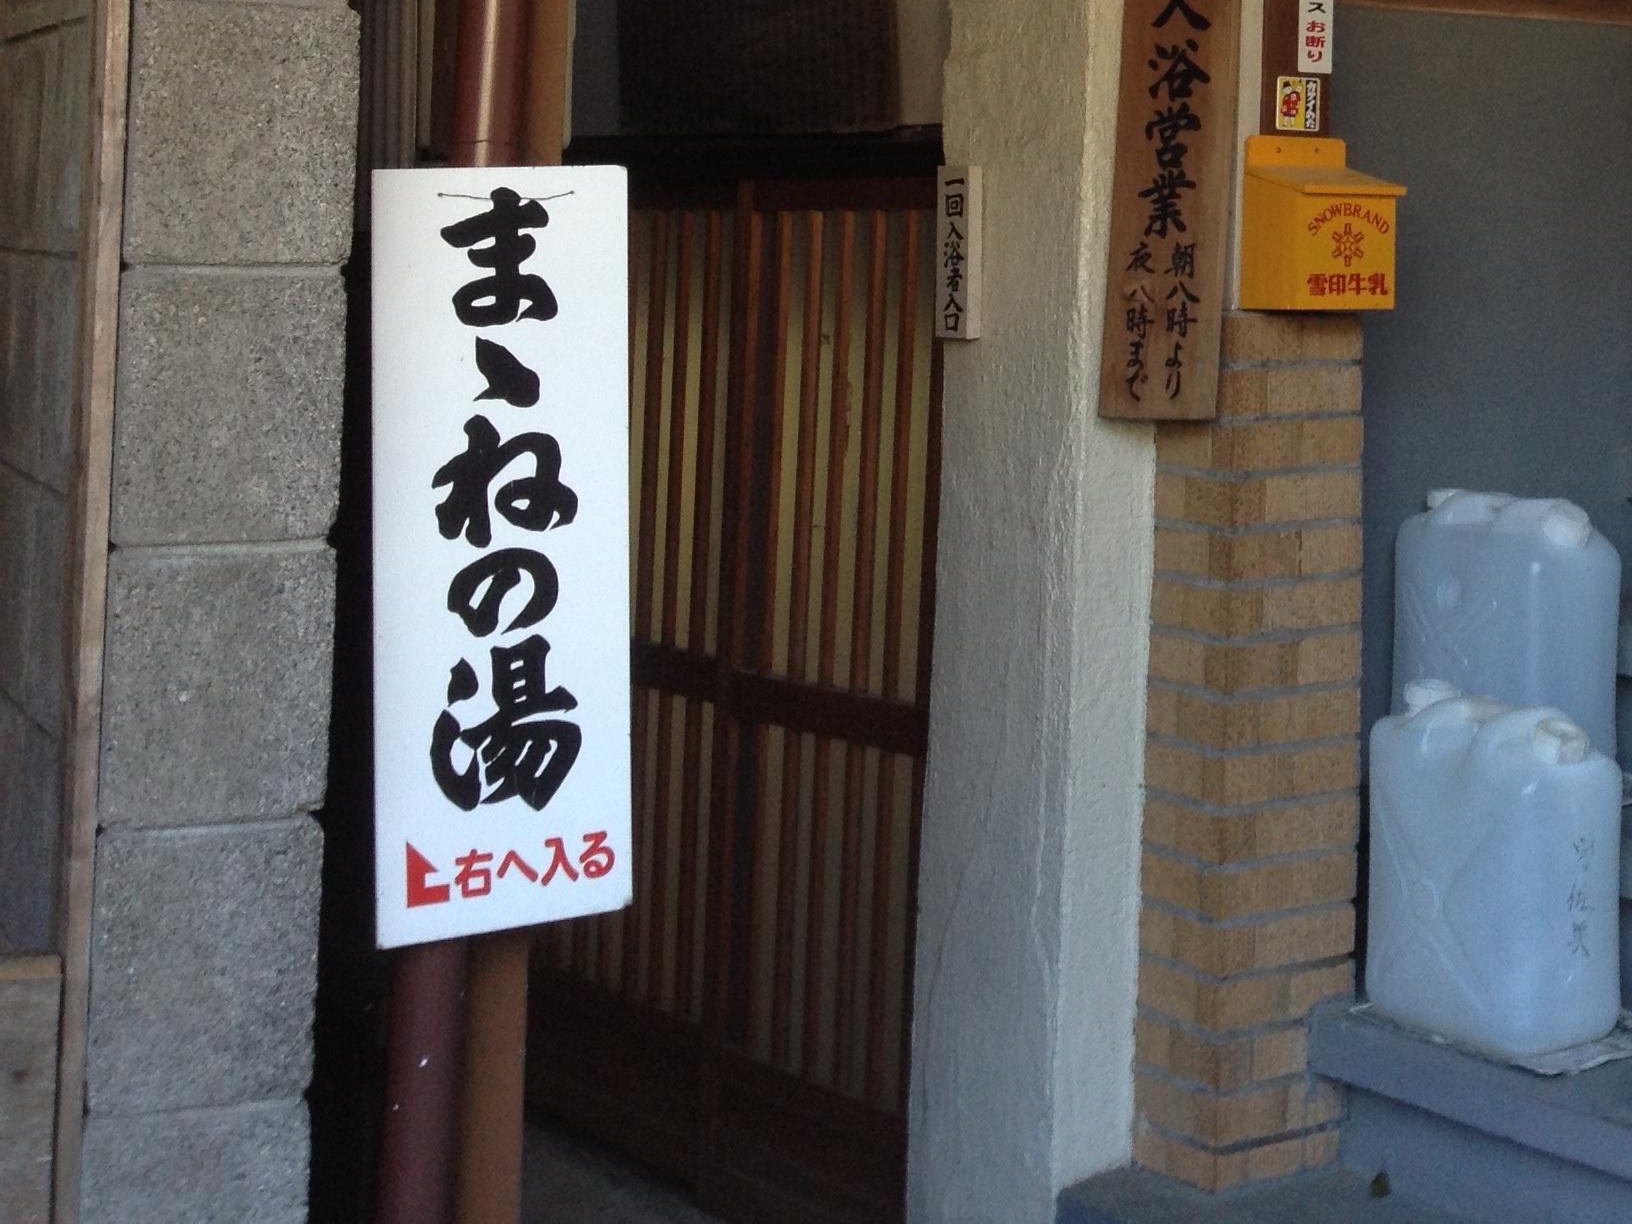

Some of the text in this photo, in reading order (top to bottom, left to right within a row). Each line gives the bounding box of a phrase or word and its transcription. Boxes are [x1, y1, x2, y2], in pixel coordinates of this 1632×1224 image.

[943, 177, 965, 334] 一回入浴者入口
[1125, 241, 1155, 402] 夜八時まで
[1164, 241, 1200, 400] 朝八時より
[1306, 272, 1389, 296] 雪印牛乳
[454, 830, 616, 898] 右へ入る
